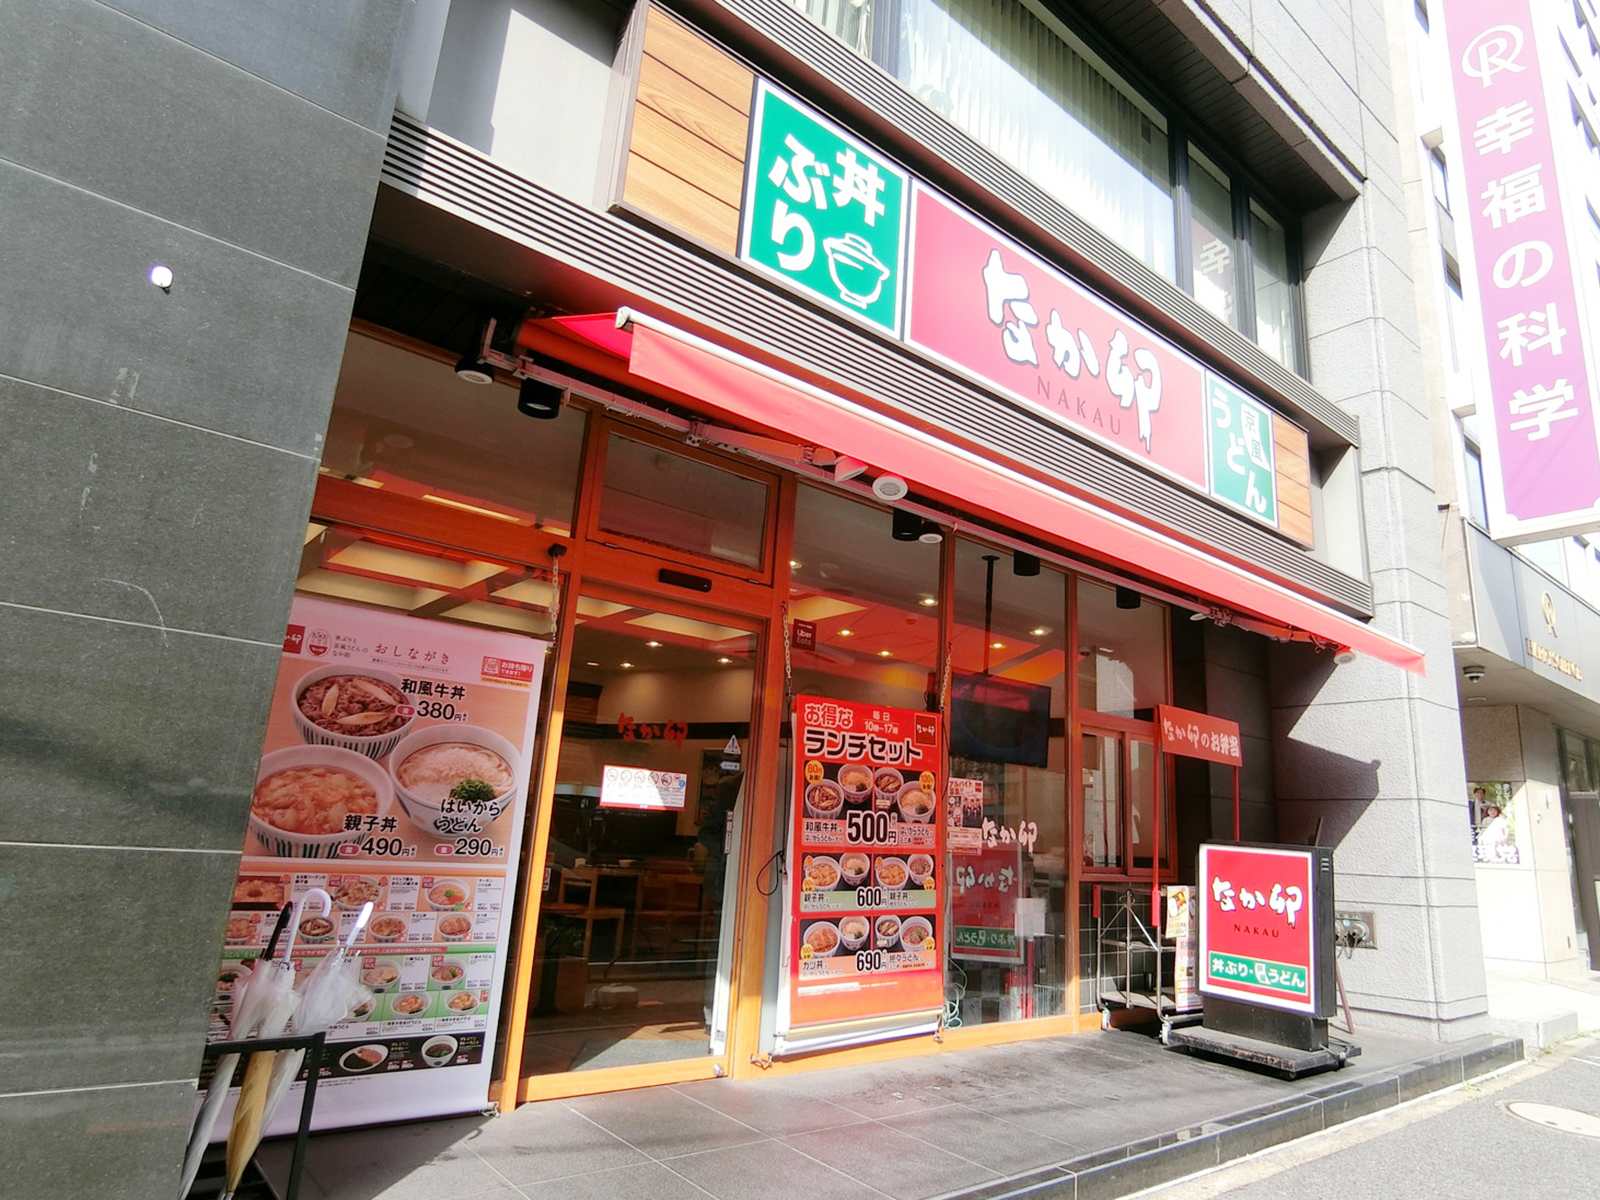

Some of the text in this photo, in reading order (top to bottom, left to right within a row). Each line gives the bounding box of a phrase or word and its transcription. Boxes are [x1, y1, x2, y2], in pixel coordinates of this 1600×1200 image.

[1473, 99, 1580, 442] 幸福の科学
[982, 248, 1162, 455] なか卯
[1037, 375, 1121, 436] NAKAU
[1212, 386, 1267, 514] うどん
[375, 642, 451, 665] おしながき
[400, 677, 466, 701] 和風牛丼
[804, 703, 853, 728] お得な
[872, 710, 891, 722] 毎日
[617, 712, 689, 749] なか卯
[916, 724, 936, 736] なか卯
[1163, 717, 1240, 758] なか卯のお弁当
[804, 728, 922, 766] ランチセット
[440, 798, 501, 817] はいから
[344, 814, 398, 834] 親子丼
[438, 816, 482, 833] うどん
[805, 821, 838, 833] 和風牛丼
[982, 816, 1037, 855] なか卯
[1211, 875, 1304, 929] なか卯
[1233, 923, 1280, 939] NAKAU
[803, 960, 823, 970] カツ丼
